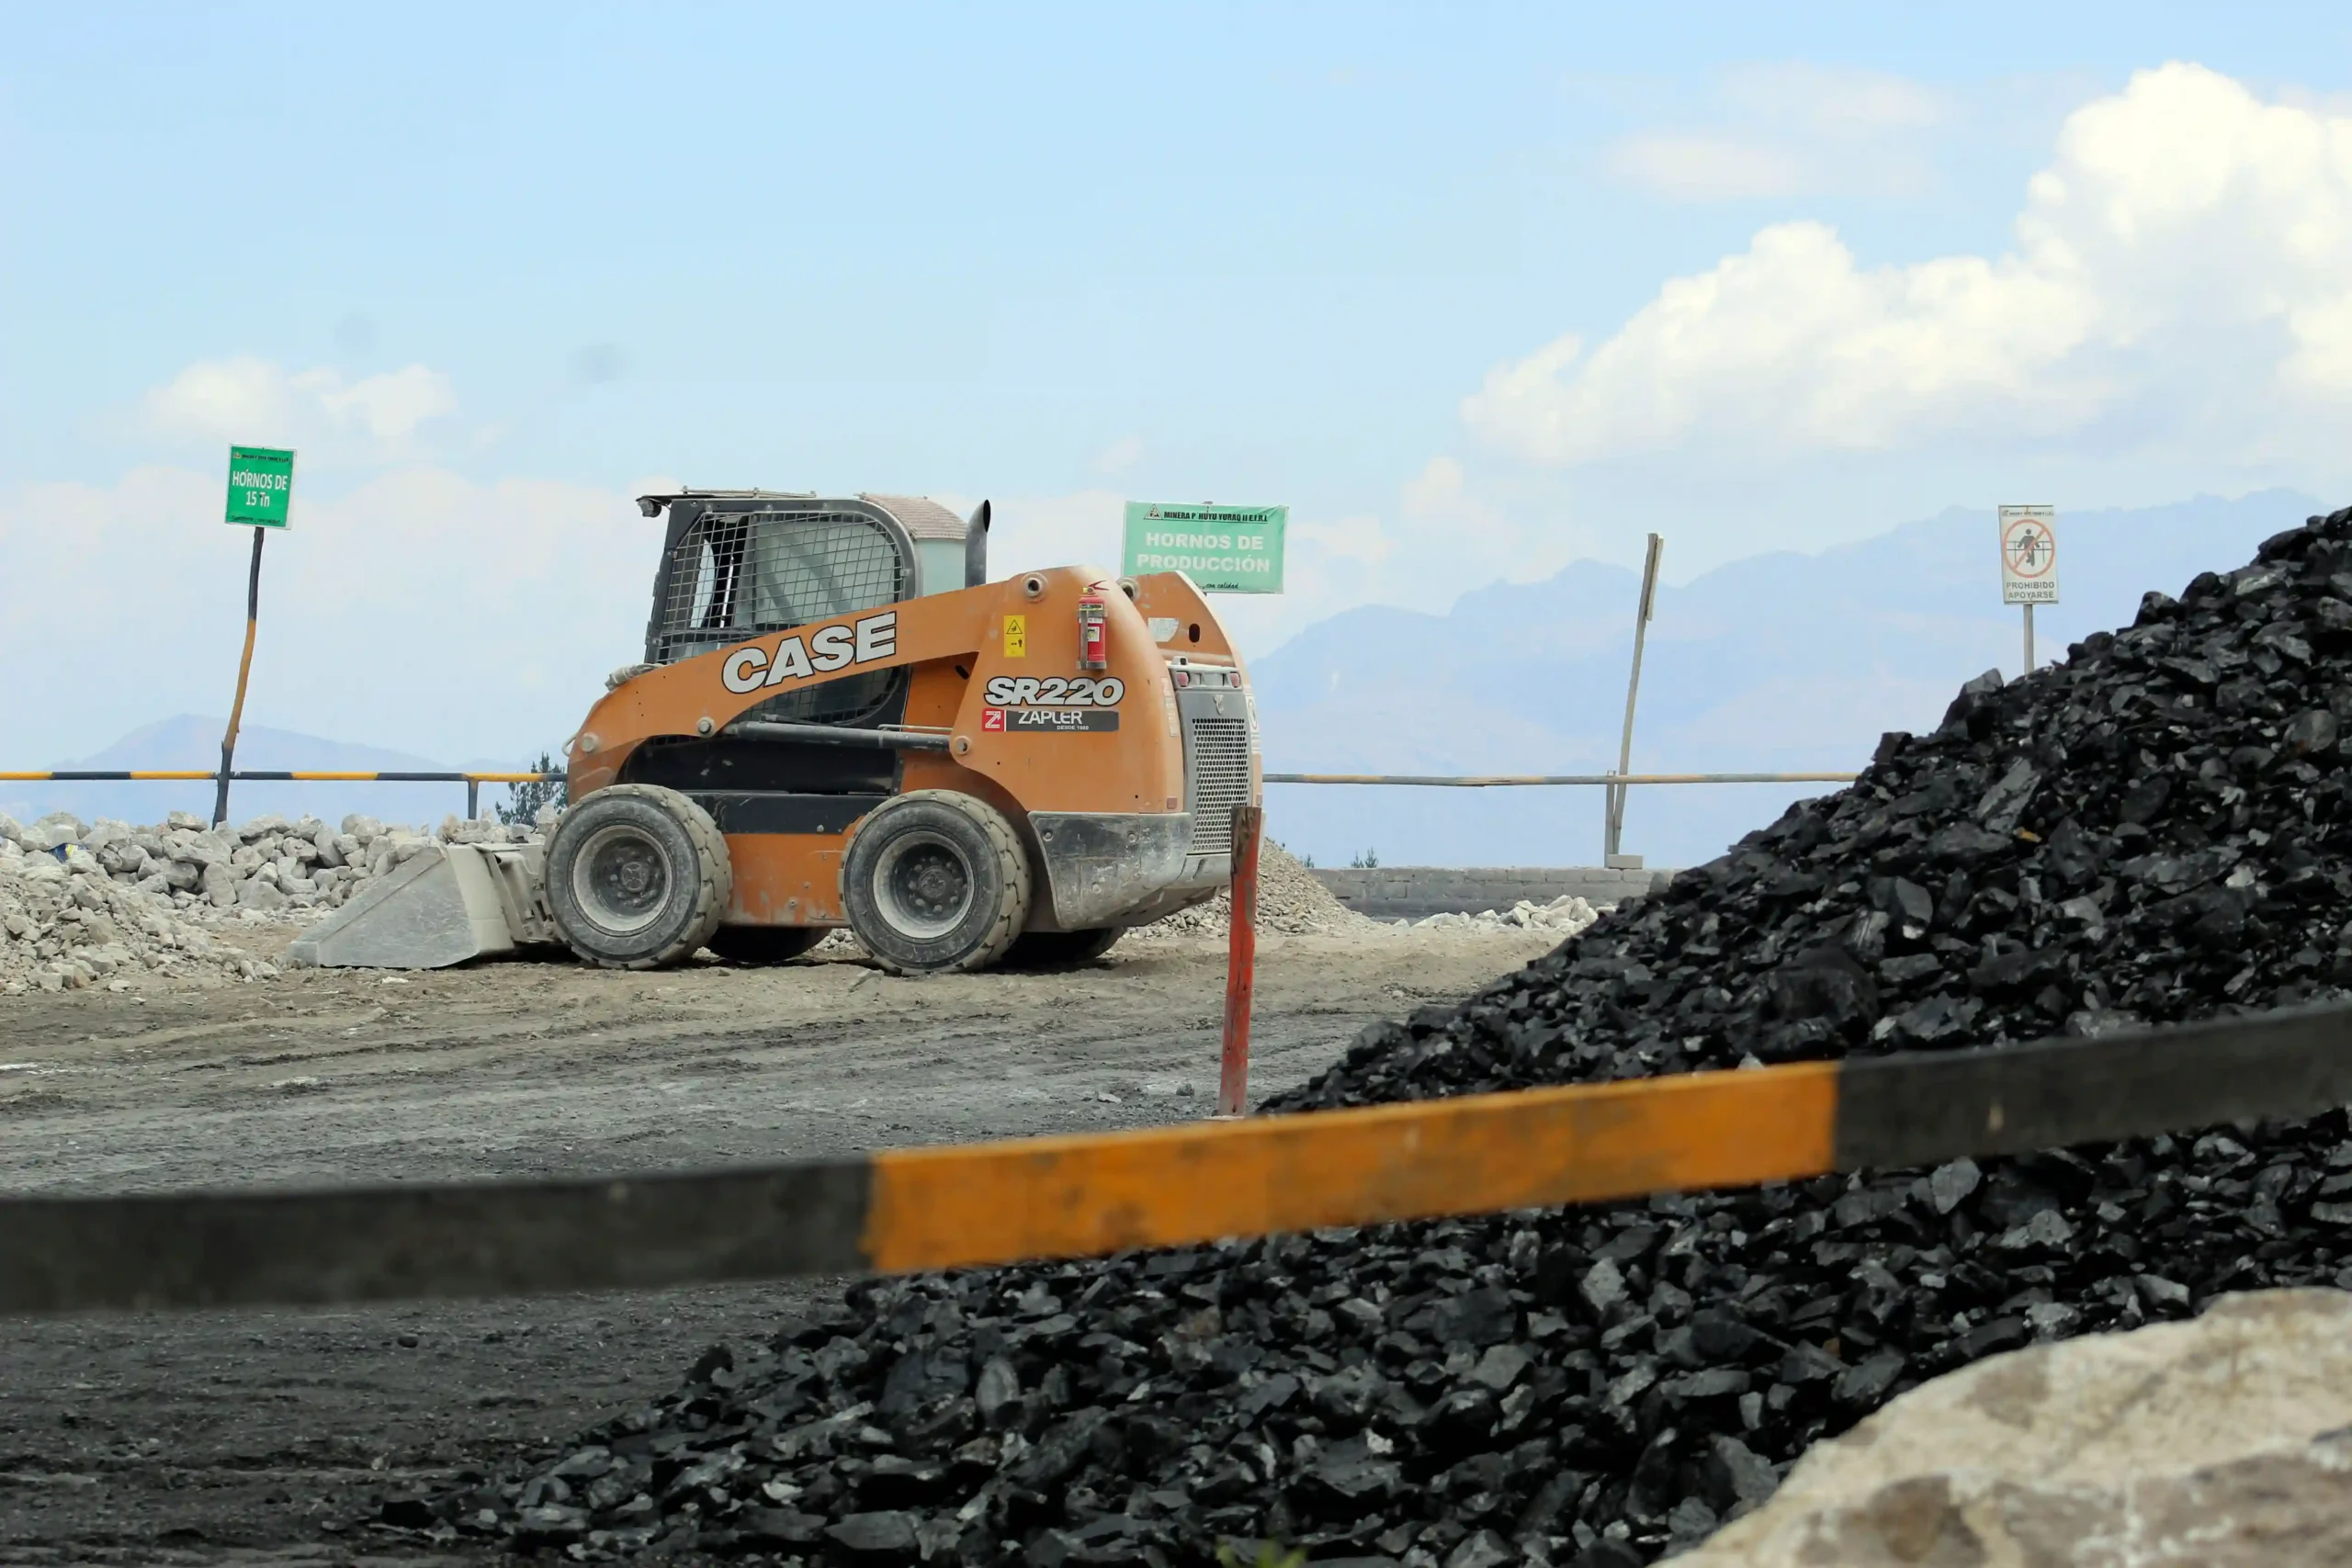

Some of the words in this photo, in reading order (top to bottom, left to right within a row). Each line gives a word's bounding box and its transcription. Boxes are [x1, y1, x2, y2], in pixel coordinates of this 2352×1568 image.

[275, 474, 288, 491] DE
[245, 491, 257, 506] 15
[1163, 511, 1191, 520] MINERA
[1146, 532, 1232, 549] HORNOS
[1238, 536, 1264, 550] DE
[1136, 553, 1271, 573] PRODUCCIÓN
[2007, 591, 2054, 599] APOYARSE
[721, 611, 897, 694] CASE
[984, 676, 1125, 707] SR220
[1018, 711, 1083, 725] ZAPLER
